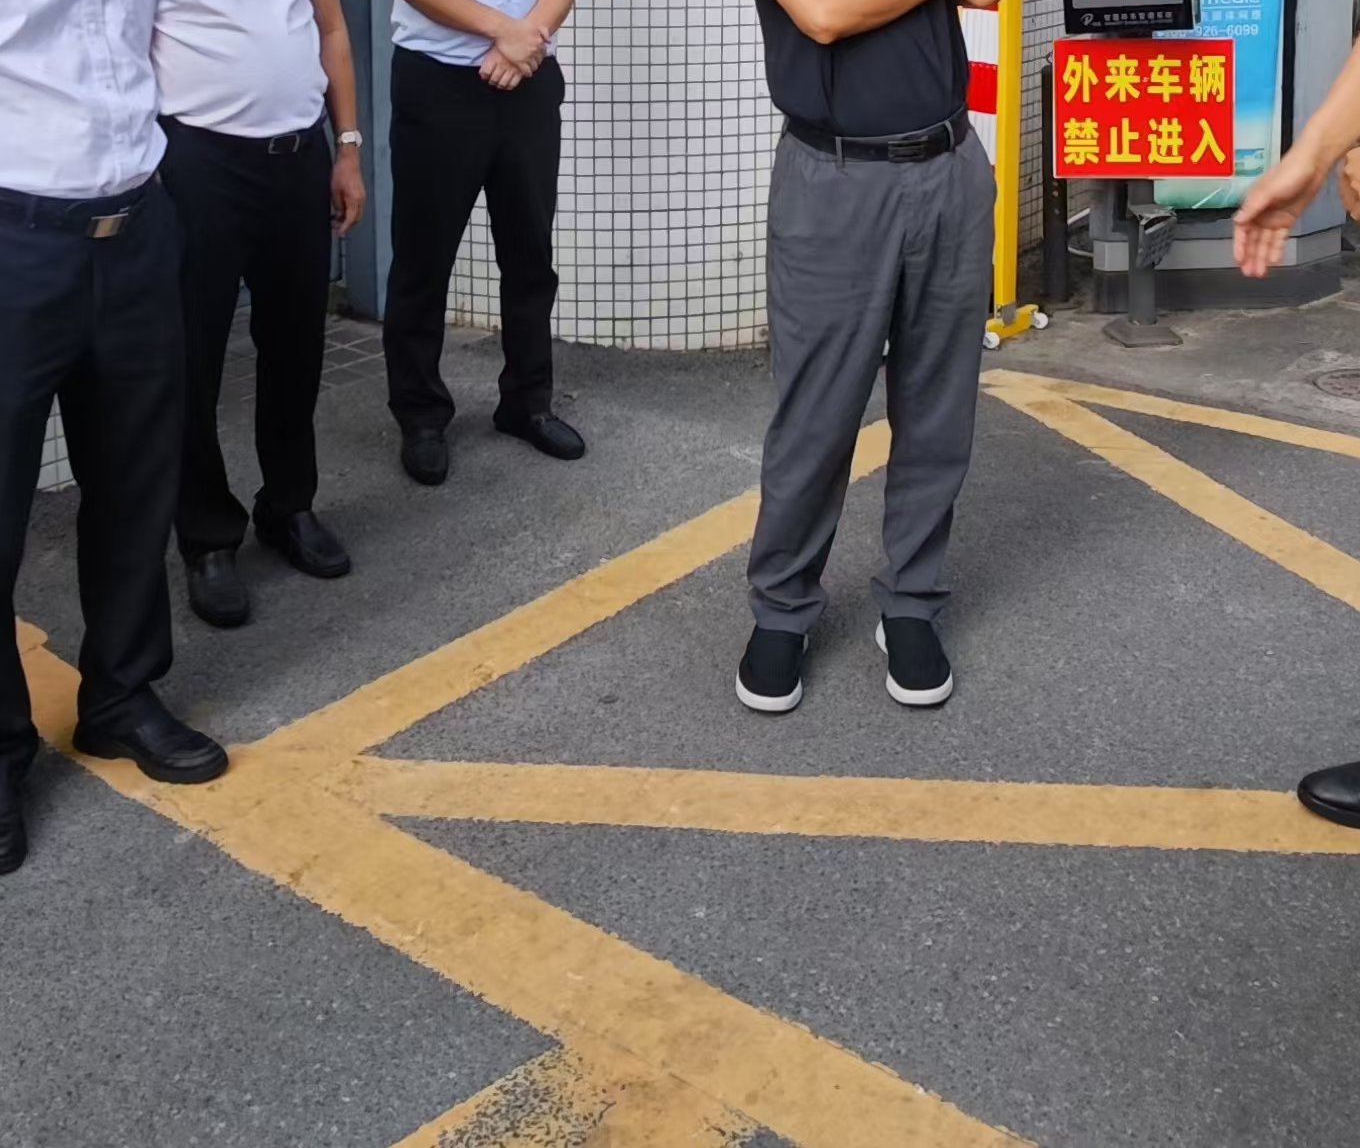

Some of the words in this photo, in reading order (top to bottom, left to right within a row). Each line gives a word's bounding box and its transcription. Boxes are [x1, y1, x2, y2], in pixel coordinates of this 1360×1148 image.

[1062, 54, 1227, 103] 外来车辆
[1063, 117, 1227, 165] 禁止进入
